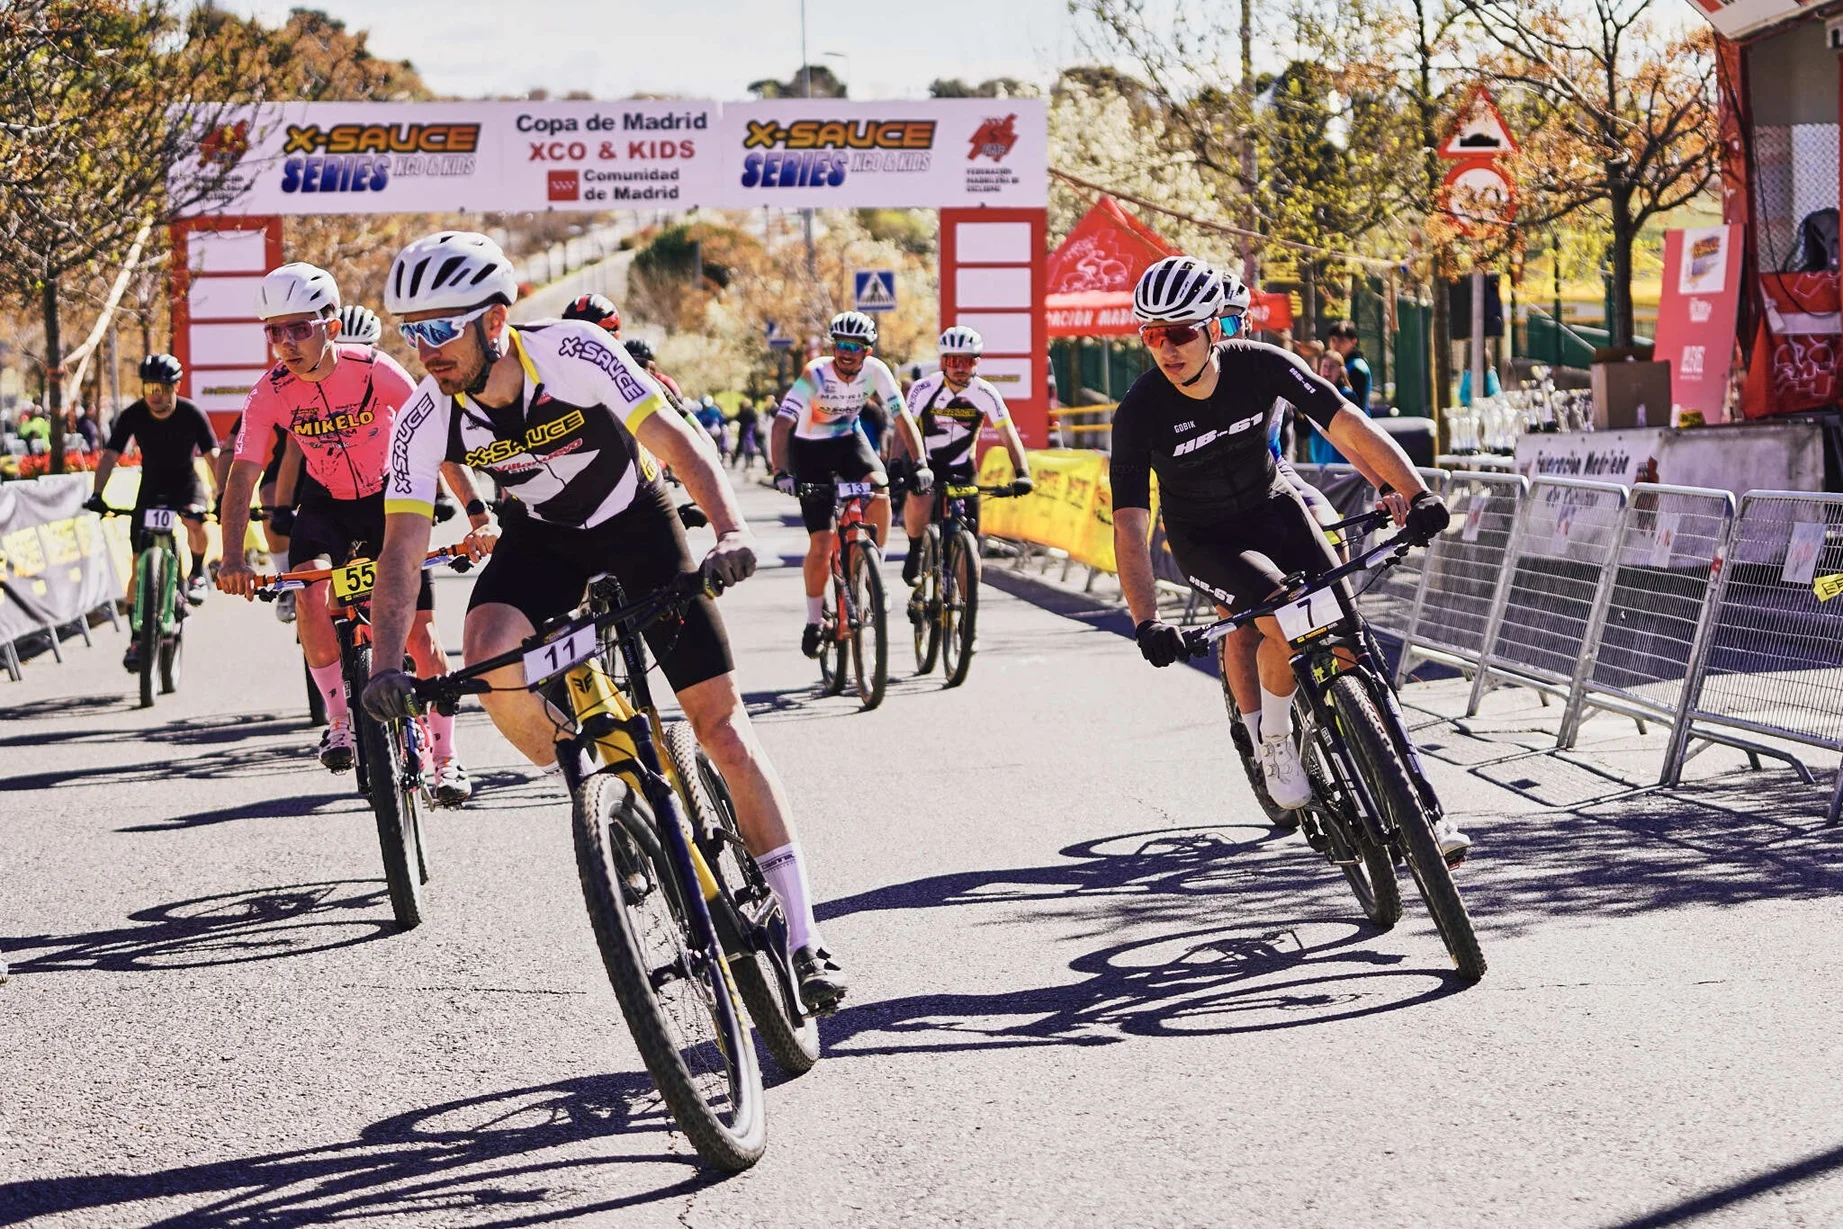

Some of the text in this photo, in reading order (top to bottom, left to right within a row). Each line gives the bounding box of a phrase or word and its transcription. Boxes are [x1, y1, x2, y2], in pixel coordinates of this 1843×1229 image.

[283, 122, 481, 154] X-SAUCE
[516, 112, 708, 136] Copa de Madrid
[743, 119, 938, 150] X-SAUCE
[528, 139, 696, 161] XCO & KIDS
[281, 154, 392, 194] SERIES
[584, 168, 680, 182] Comunidad
[741, 151, 849, 188] SERIES
[584, 186, 680, 200] de Madrid
[559, 336, 647, 403] X-SAUCE
[1289, 367, 1316, 394] HB-61
[293, 410, 375, 436] MIKELO
[464, 409, 586, 468] X-SAUCE
[1172, 411, 1264, 458] HB-61
[1173, 419, 1197, 434] GOBIK
[392, 391, 435, 495] X-SAUCE
[846, 483, 865, 494] 13
[153, 510, 170, 527] 10
[345, 563, 377, 592] 55
[1188, 575, 1236, 606] HB-61
[1296, 597, 1315, 629] 7
[544, 636, 576, 671] 11
